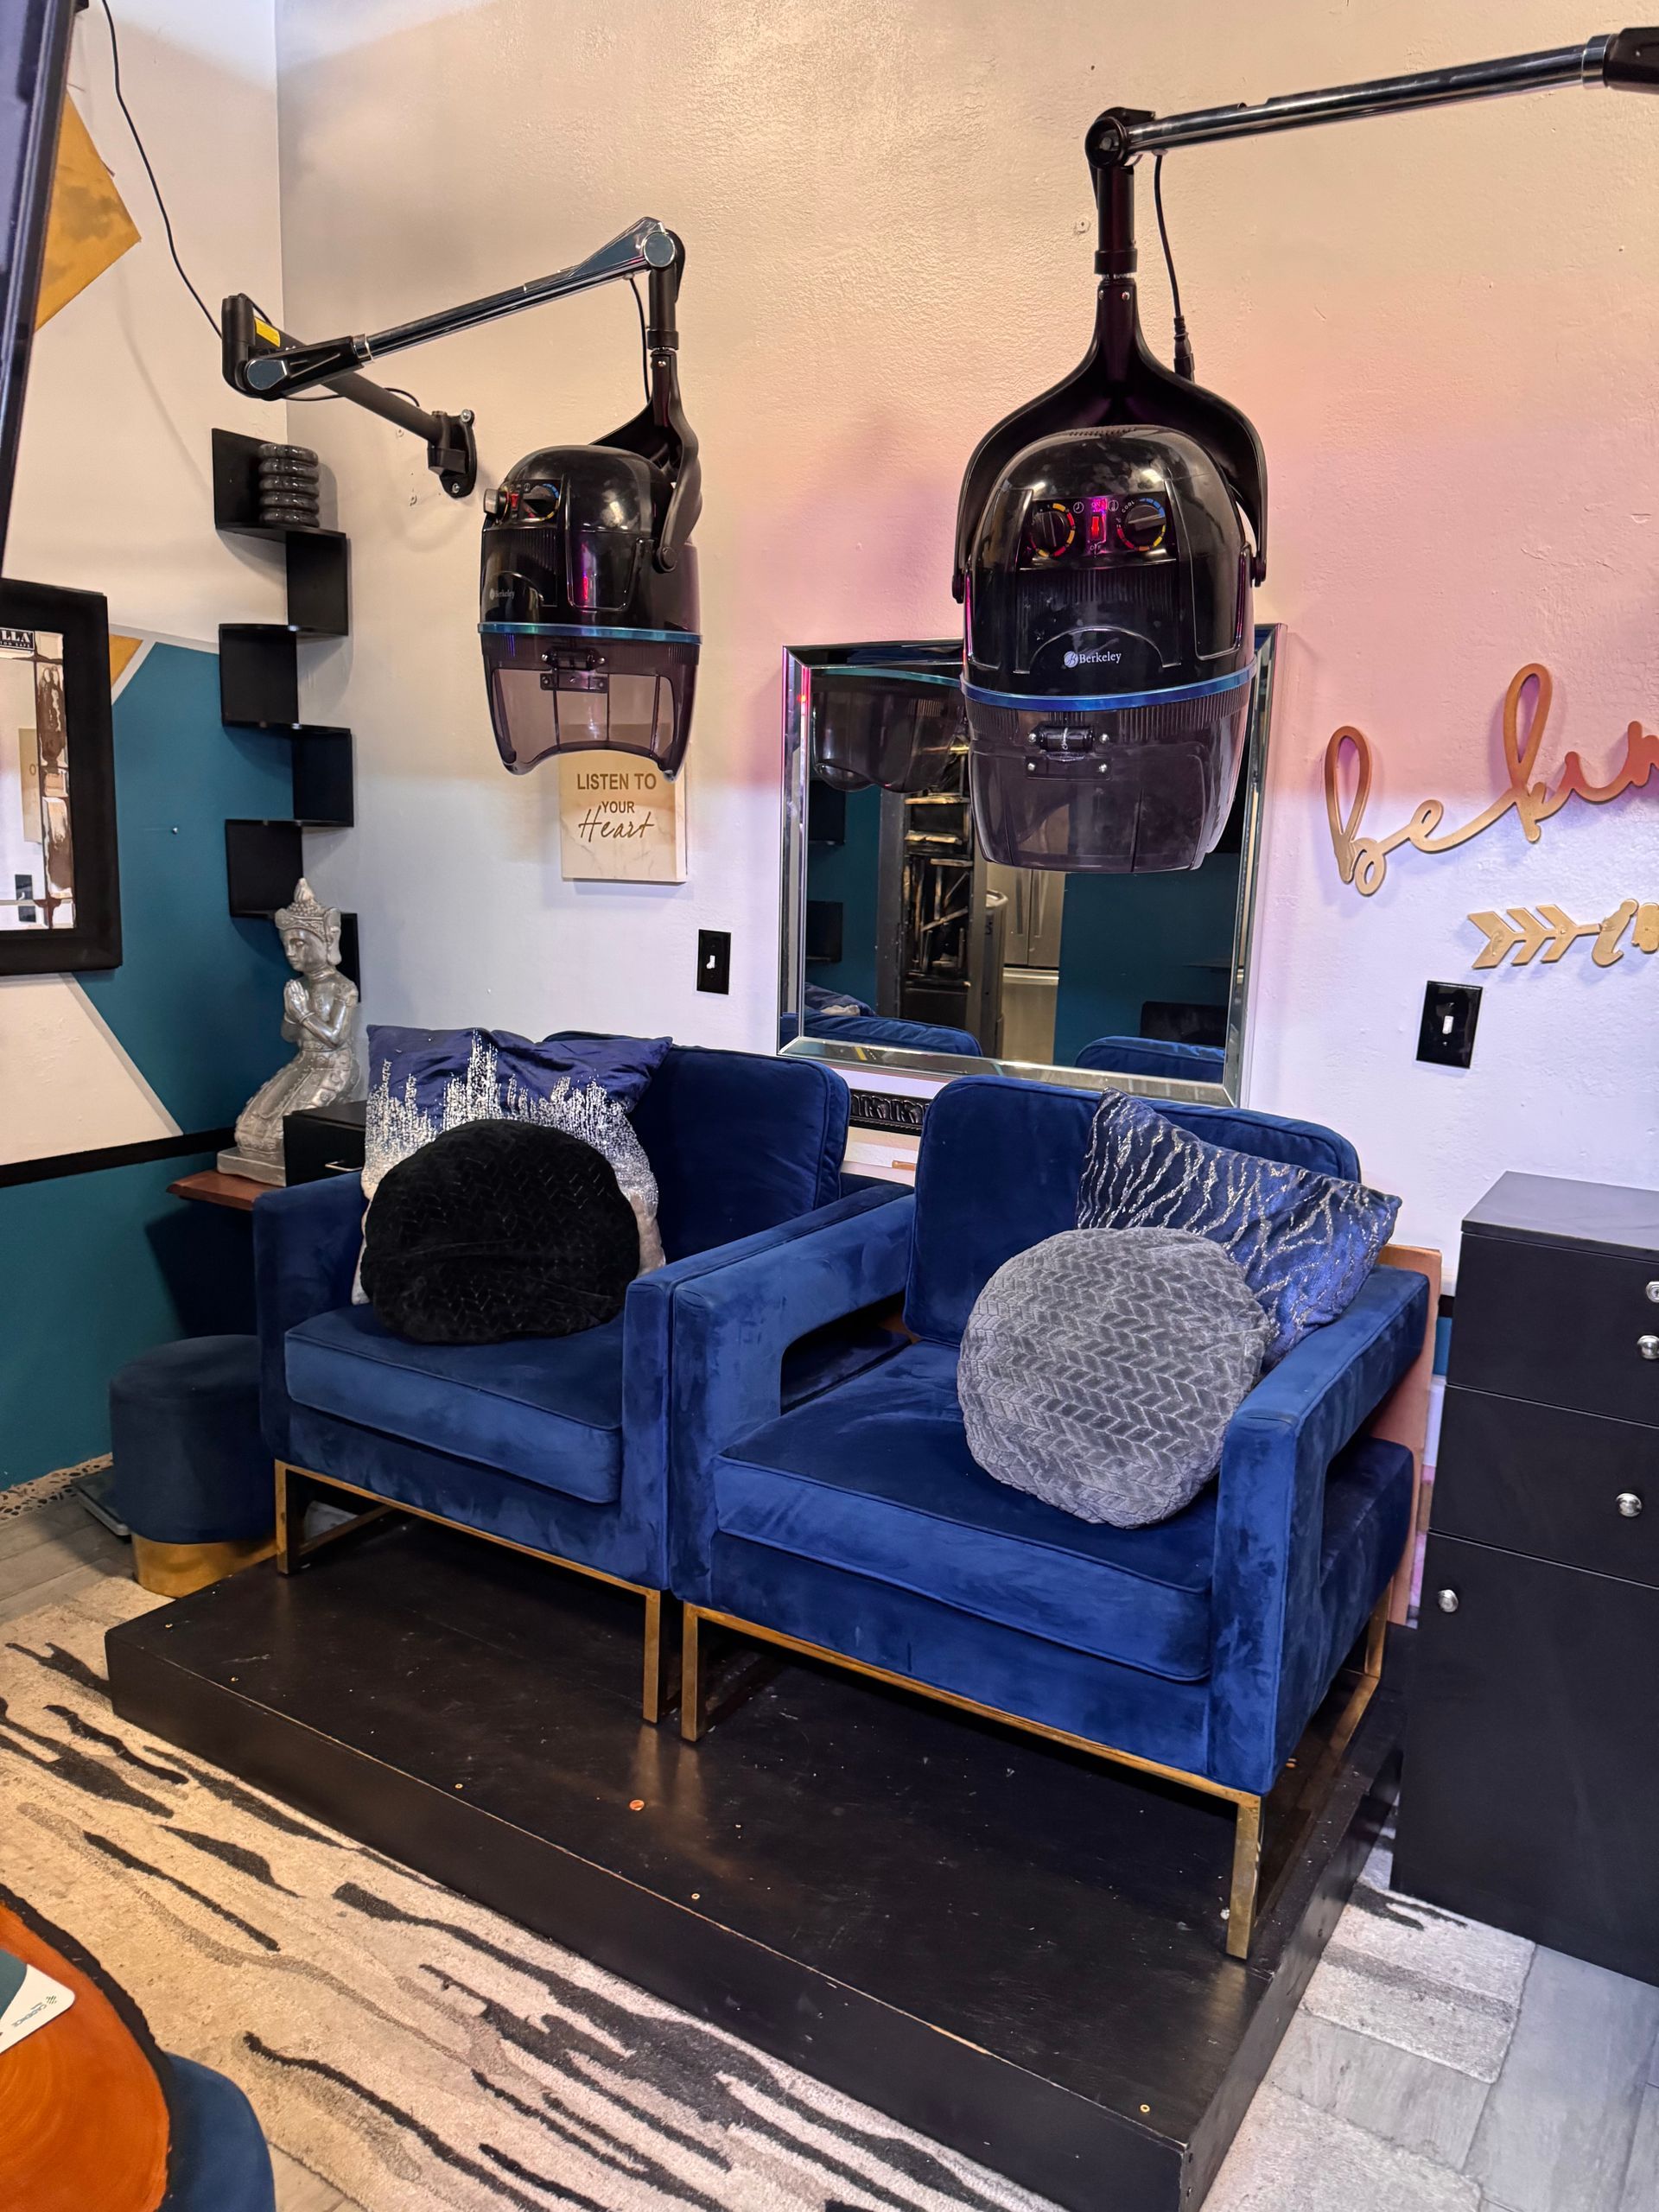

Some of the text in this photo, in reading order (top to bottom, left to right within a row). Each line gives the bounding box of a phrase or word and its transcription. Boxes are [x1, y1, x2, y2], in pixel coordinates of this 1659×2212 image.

[1079, 651, 1122, 664] Berkeley
[577, 773, 657, 790] LISTEN TO
[601, 801, 635, 813] YOUR
[1325, 726, 1502, 896] be
[578, 805, 655, 842] Heart
